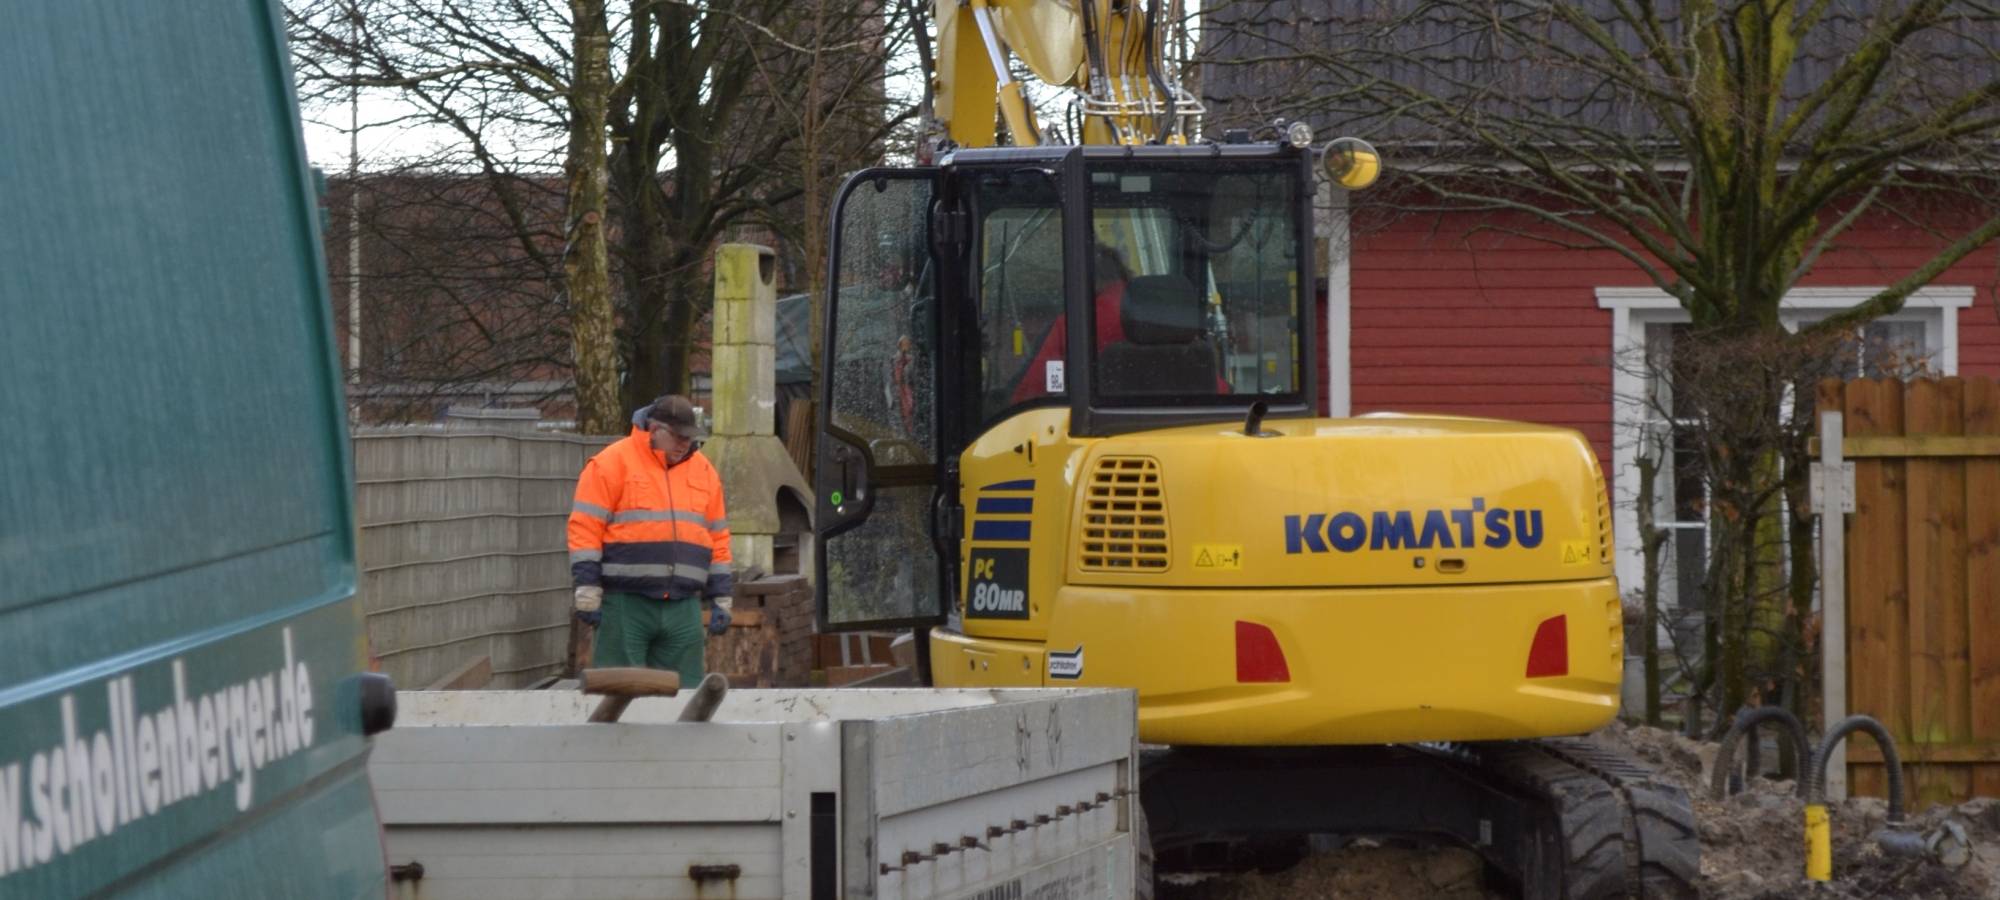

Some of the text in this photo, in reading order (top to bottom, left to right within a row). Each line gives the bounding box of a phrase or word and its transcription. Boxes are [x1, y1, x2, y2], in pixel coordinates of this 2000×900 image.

[1284, 497, 1543, 554] KOMATSU
[974, 558, 994, 580] PC
[974, 582, 1025, 611] 80MR
